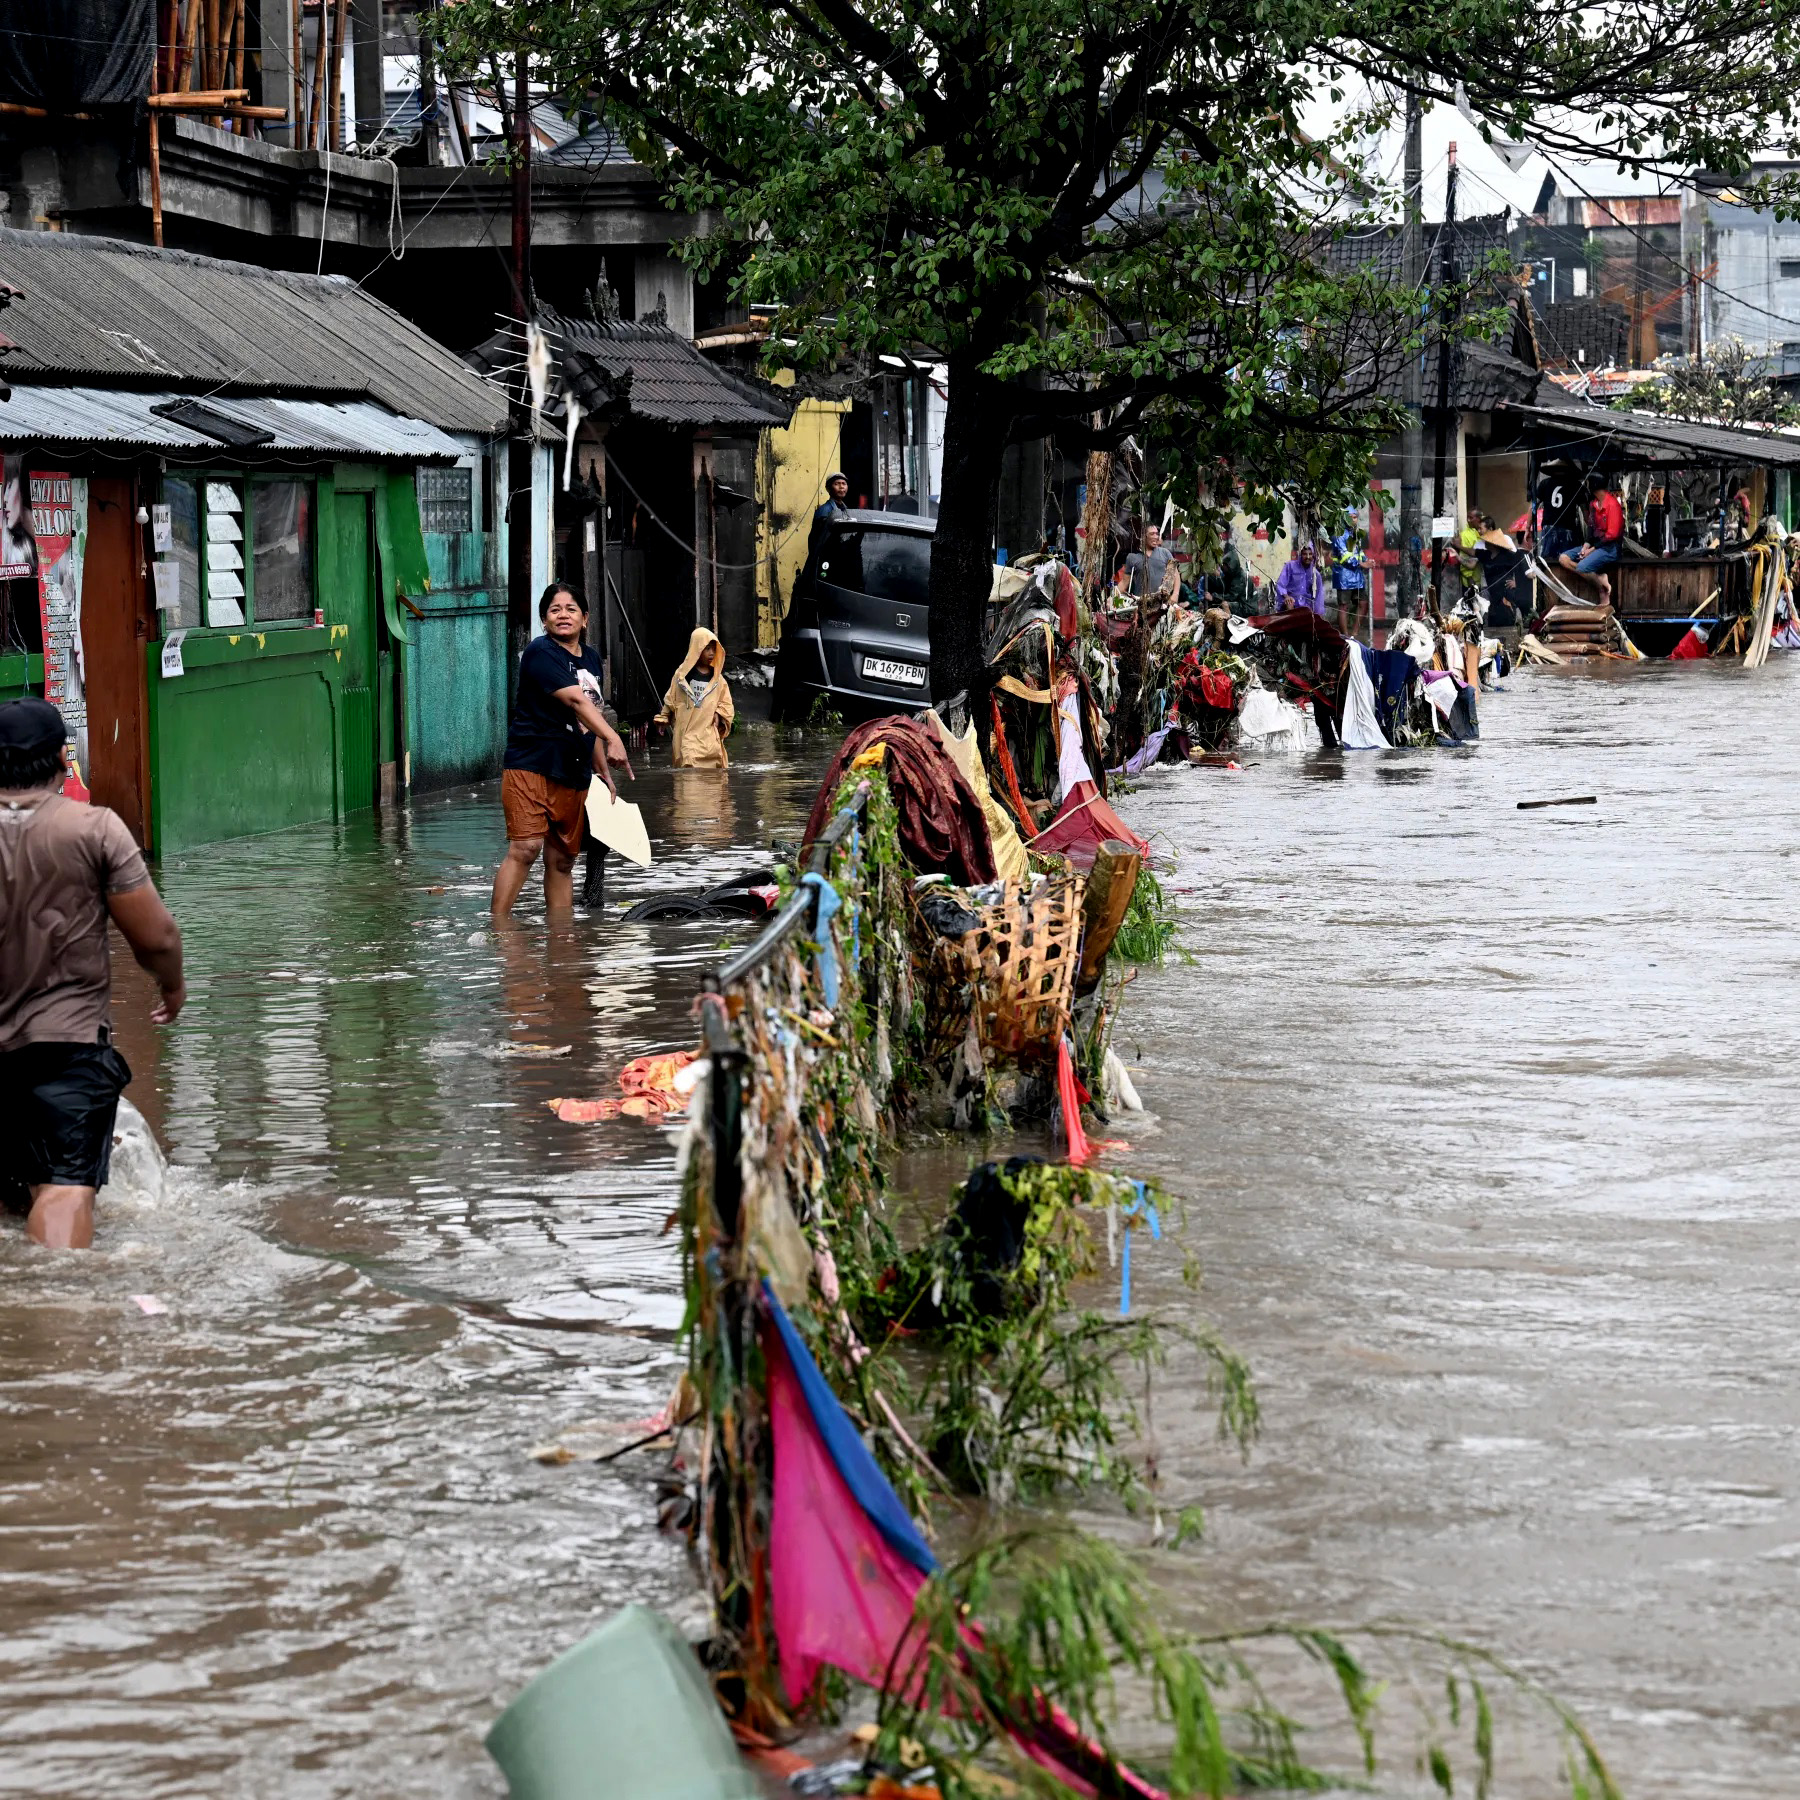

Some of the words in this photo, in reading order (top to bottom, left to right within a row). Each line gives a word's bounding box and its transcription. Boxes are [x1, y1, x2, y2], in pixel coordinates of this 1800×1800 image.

[1551, 486, 1562, 508] 6
[866, 660, 878, 670] DK
[880, 662, 904, 675] 1679
[906, 666, 924, 679] FBN
